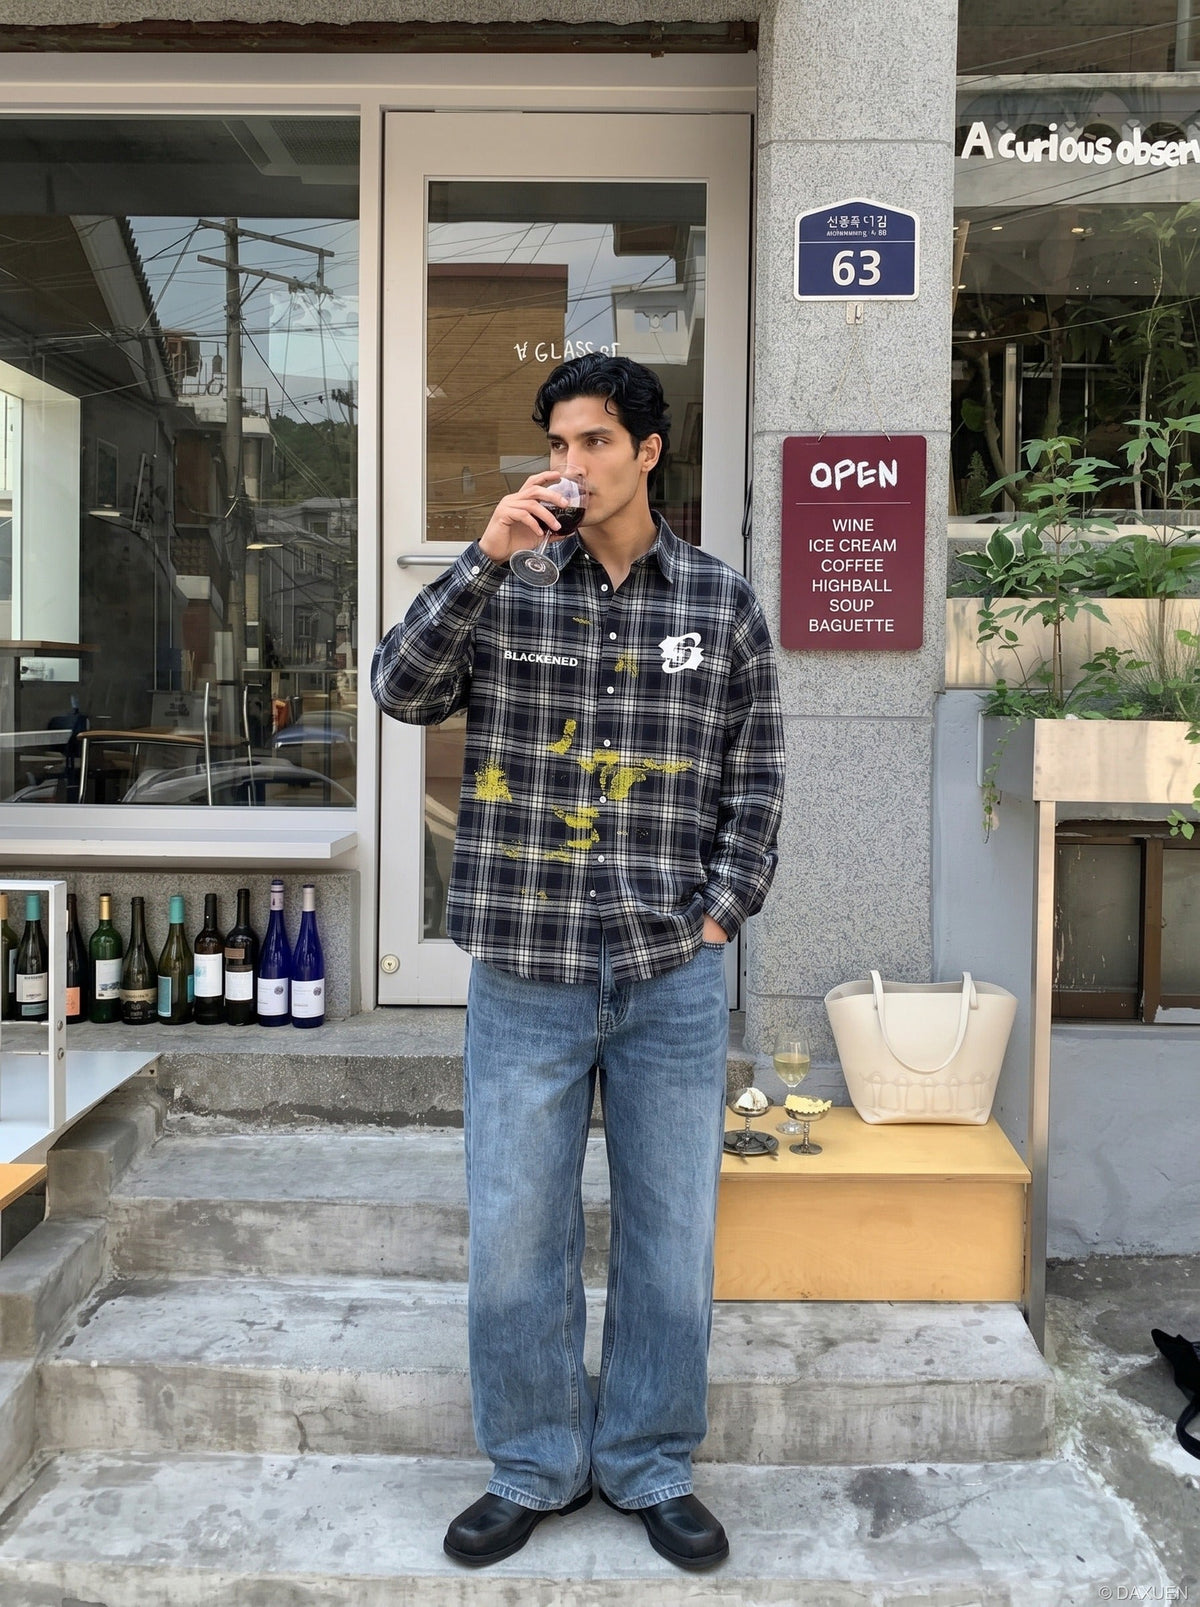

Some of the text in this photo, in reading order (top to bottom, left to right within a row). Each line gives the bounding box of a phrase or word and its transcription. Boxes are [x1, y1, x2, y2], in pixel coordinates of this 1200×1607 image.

[961, 121, 994, 160] A
[998, 123, 1112, 165] curious
[832, 250, 881, 286] 63
[810, 459, 898, 491] OPEN
[832, 518, 874, 532] WINE
[808, 538, 897, 552] ICE CREAM
[820, 559, 884, 572] COFFEE
[812, 579, 892, 592] HIGHBALL
[829, 599, 874, 612] SOUP
[809, 619, 894, 632] BAGUETTE
[503, 650, 579, 667] BLACKENED
